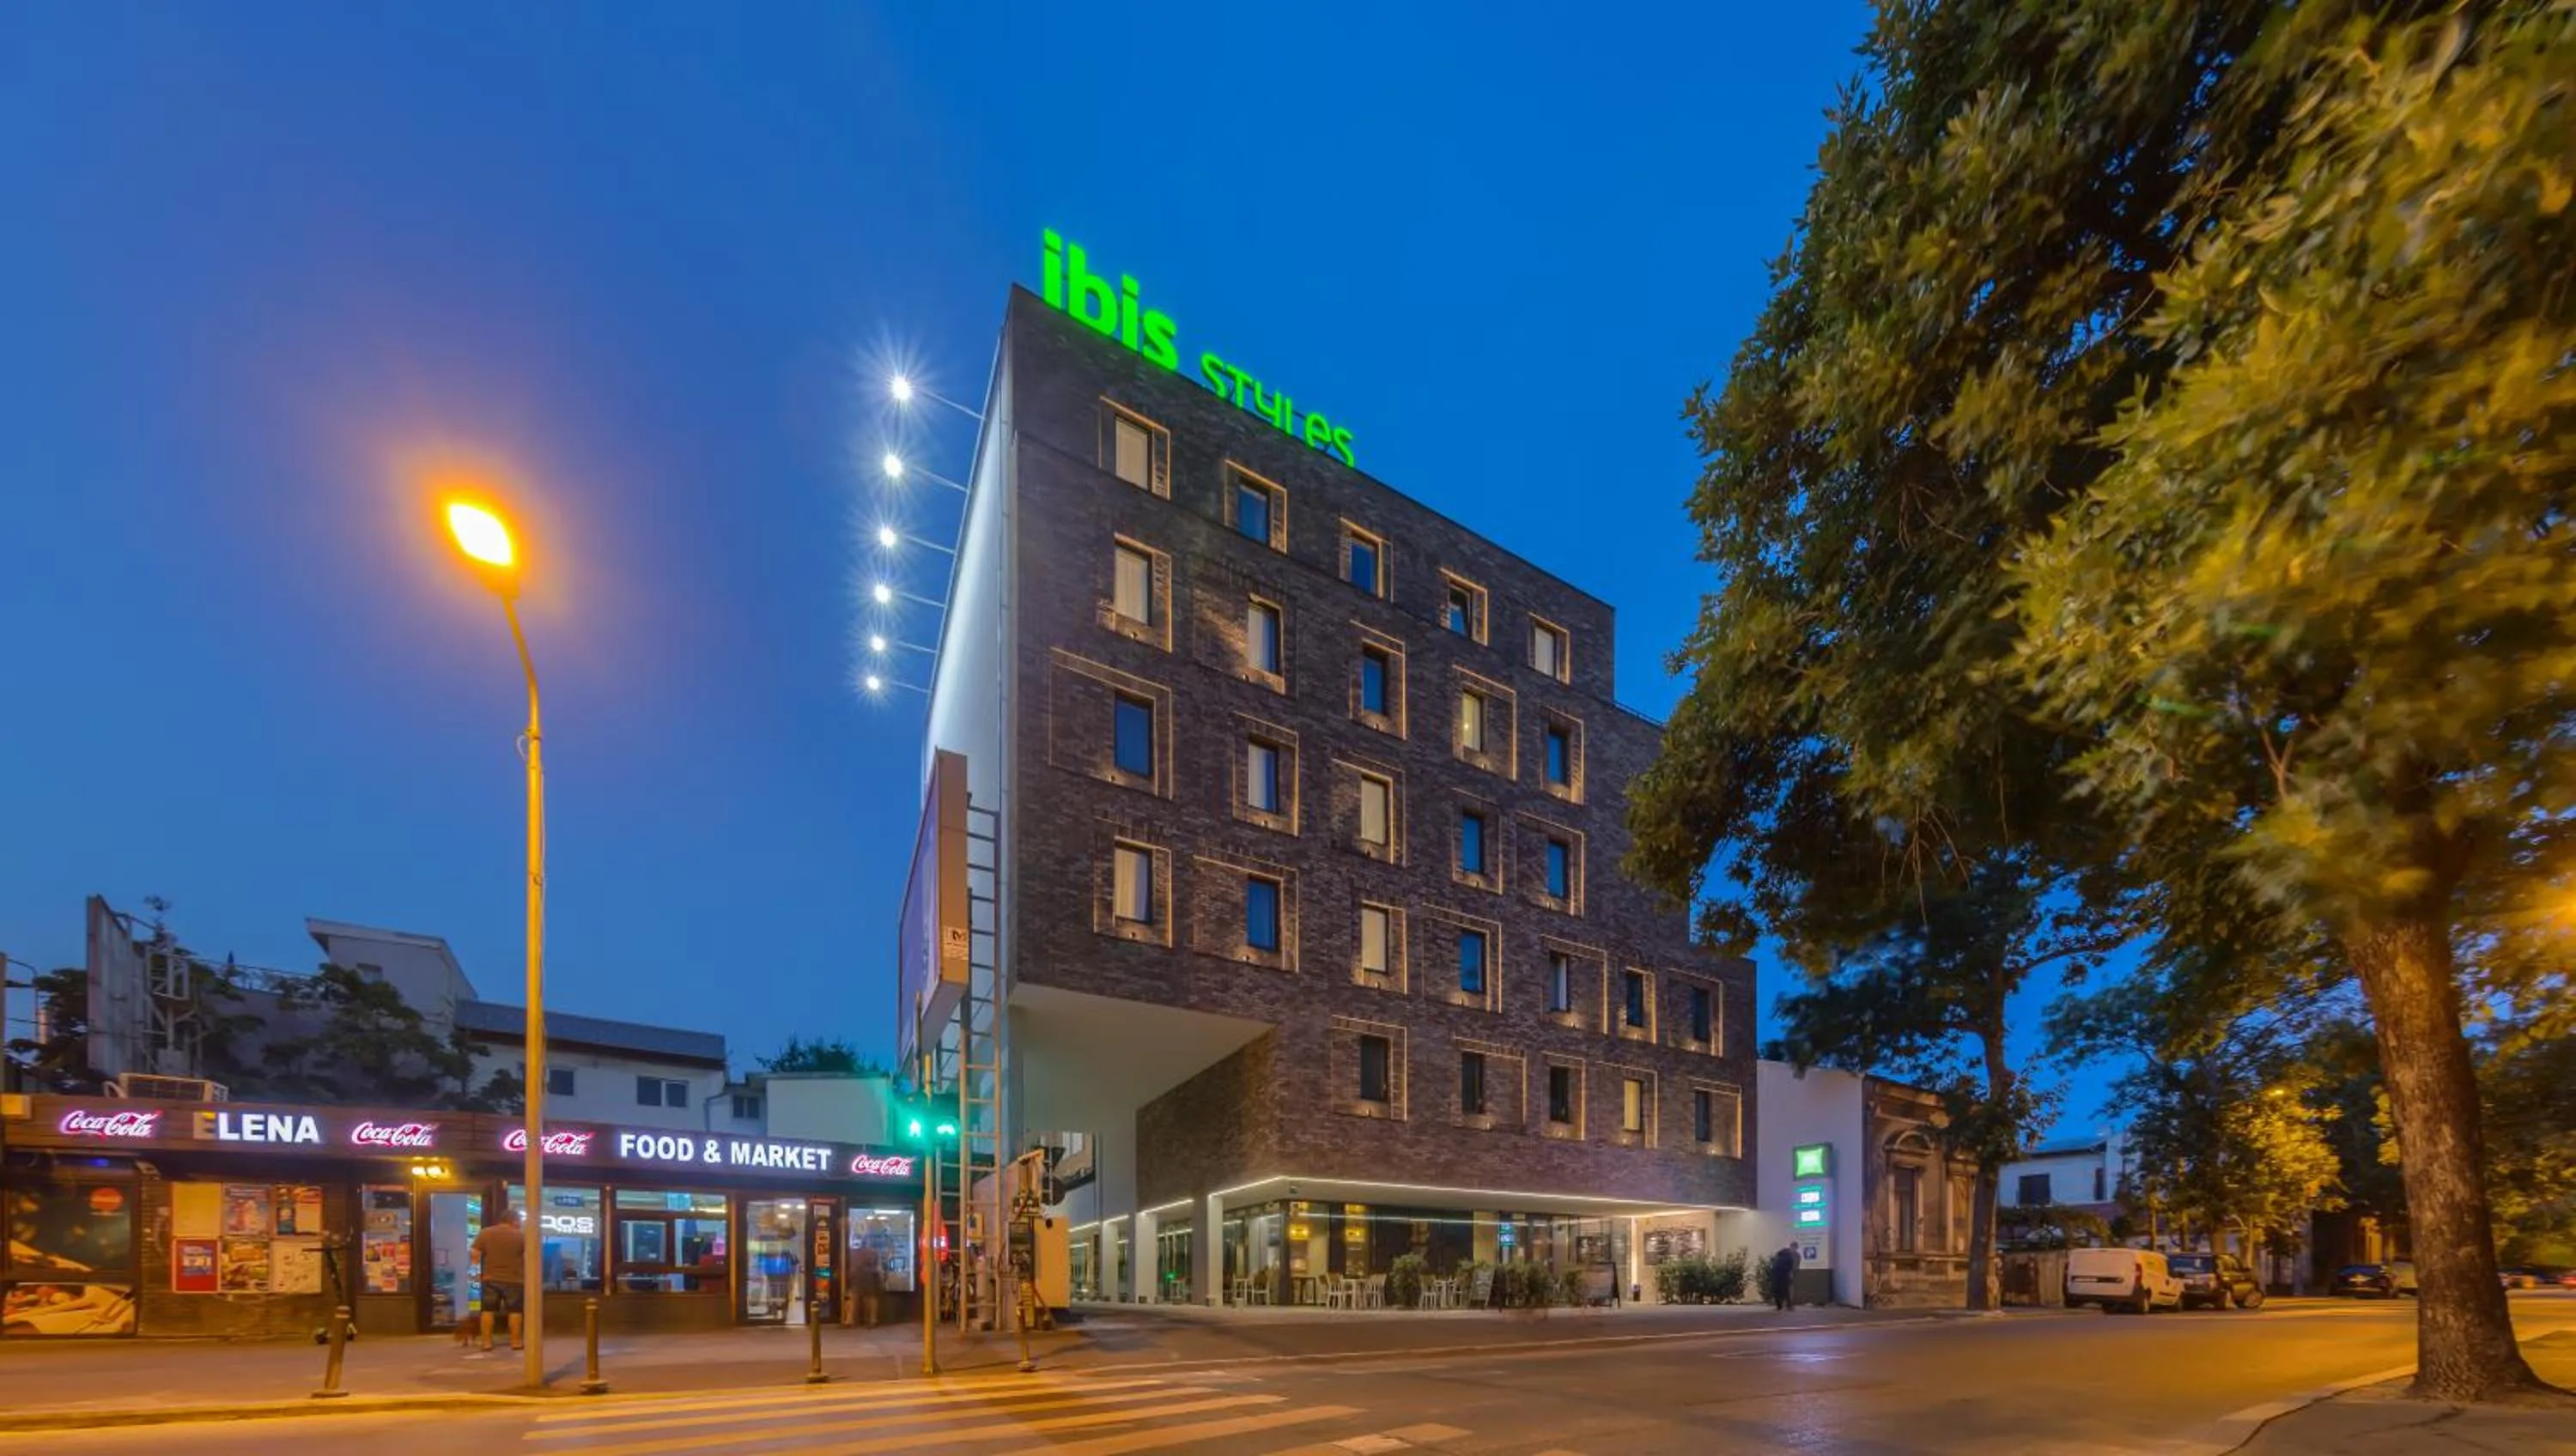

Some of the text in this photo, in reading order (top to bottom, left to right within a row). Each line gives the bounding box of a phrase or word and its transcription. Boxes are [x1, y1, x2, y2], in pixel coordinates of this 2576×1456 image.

[1043, 227, 1179, 371] ibis
[193, 1112, 321, 1144] ELENA
[620, 1133, 832, 1171] FOOD & MARKET
[540, 1215, 593, 1231] QOS
